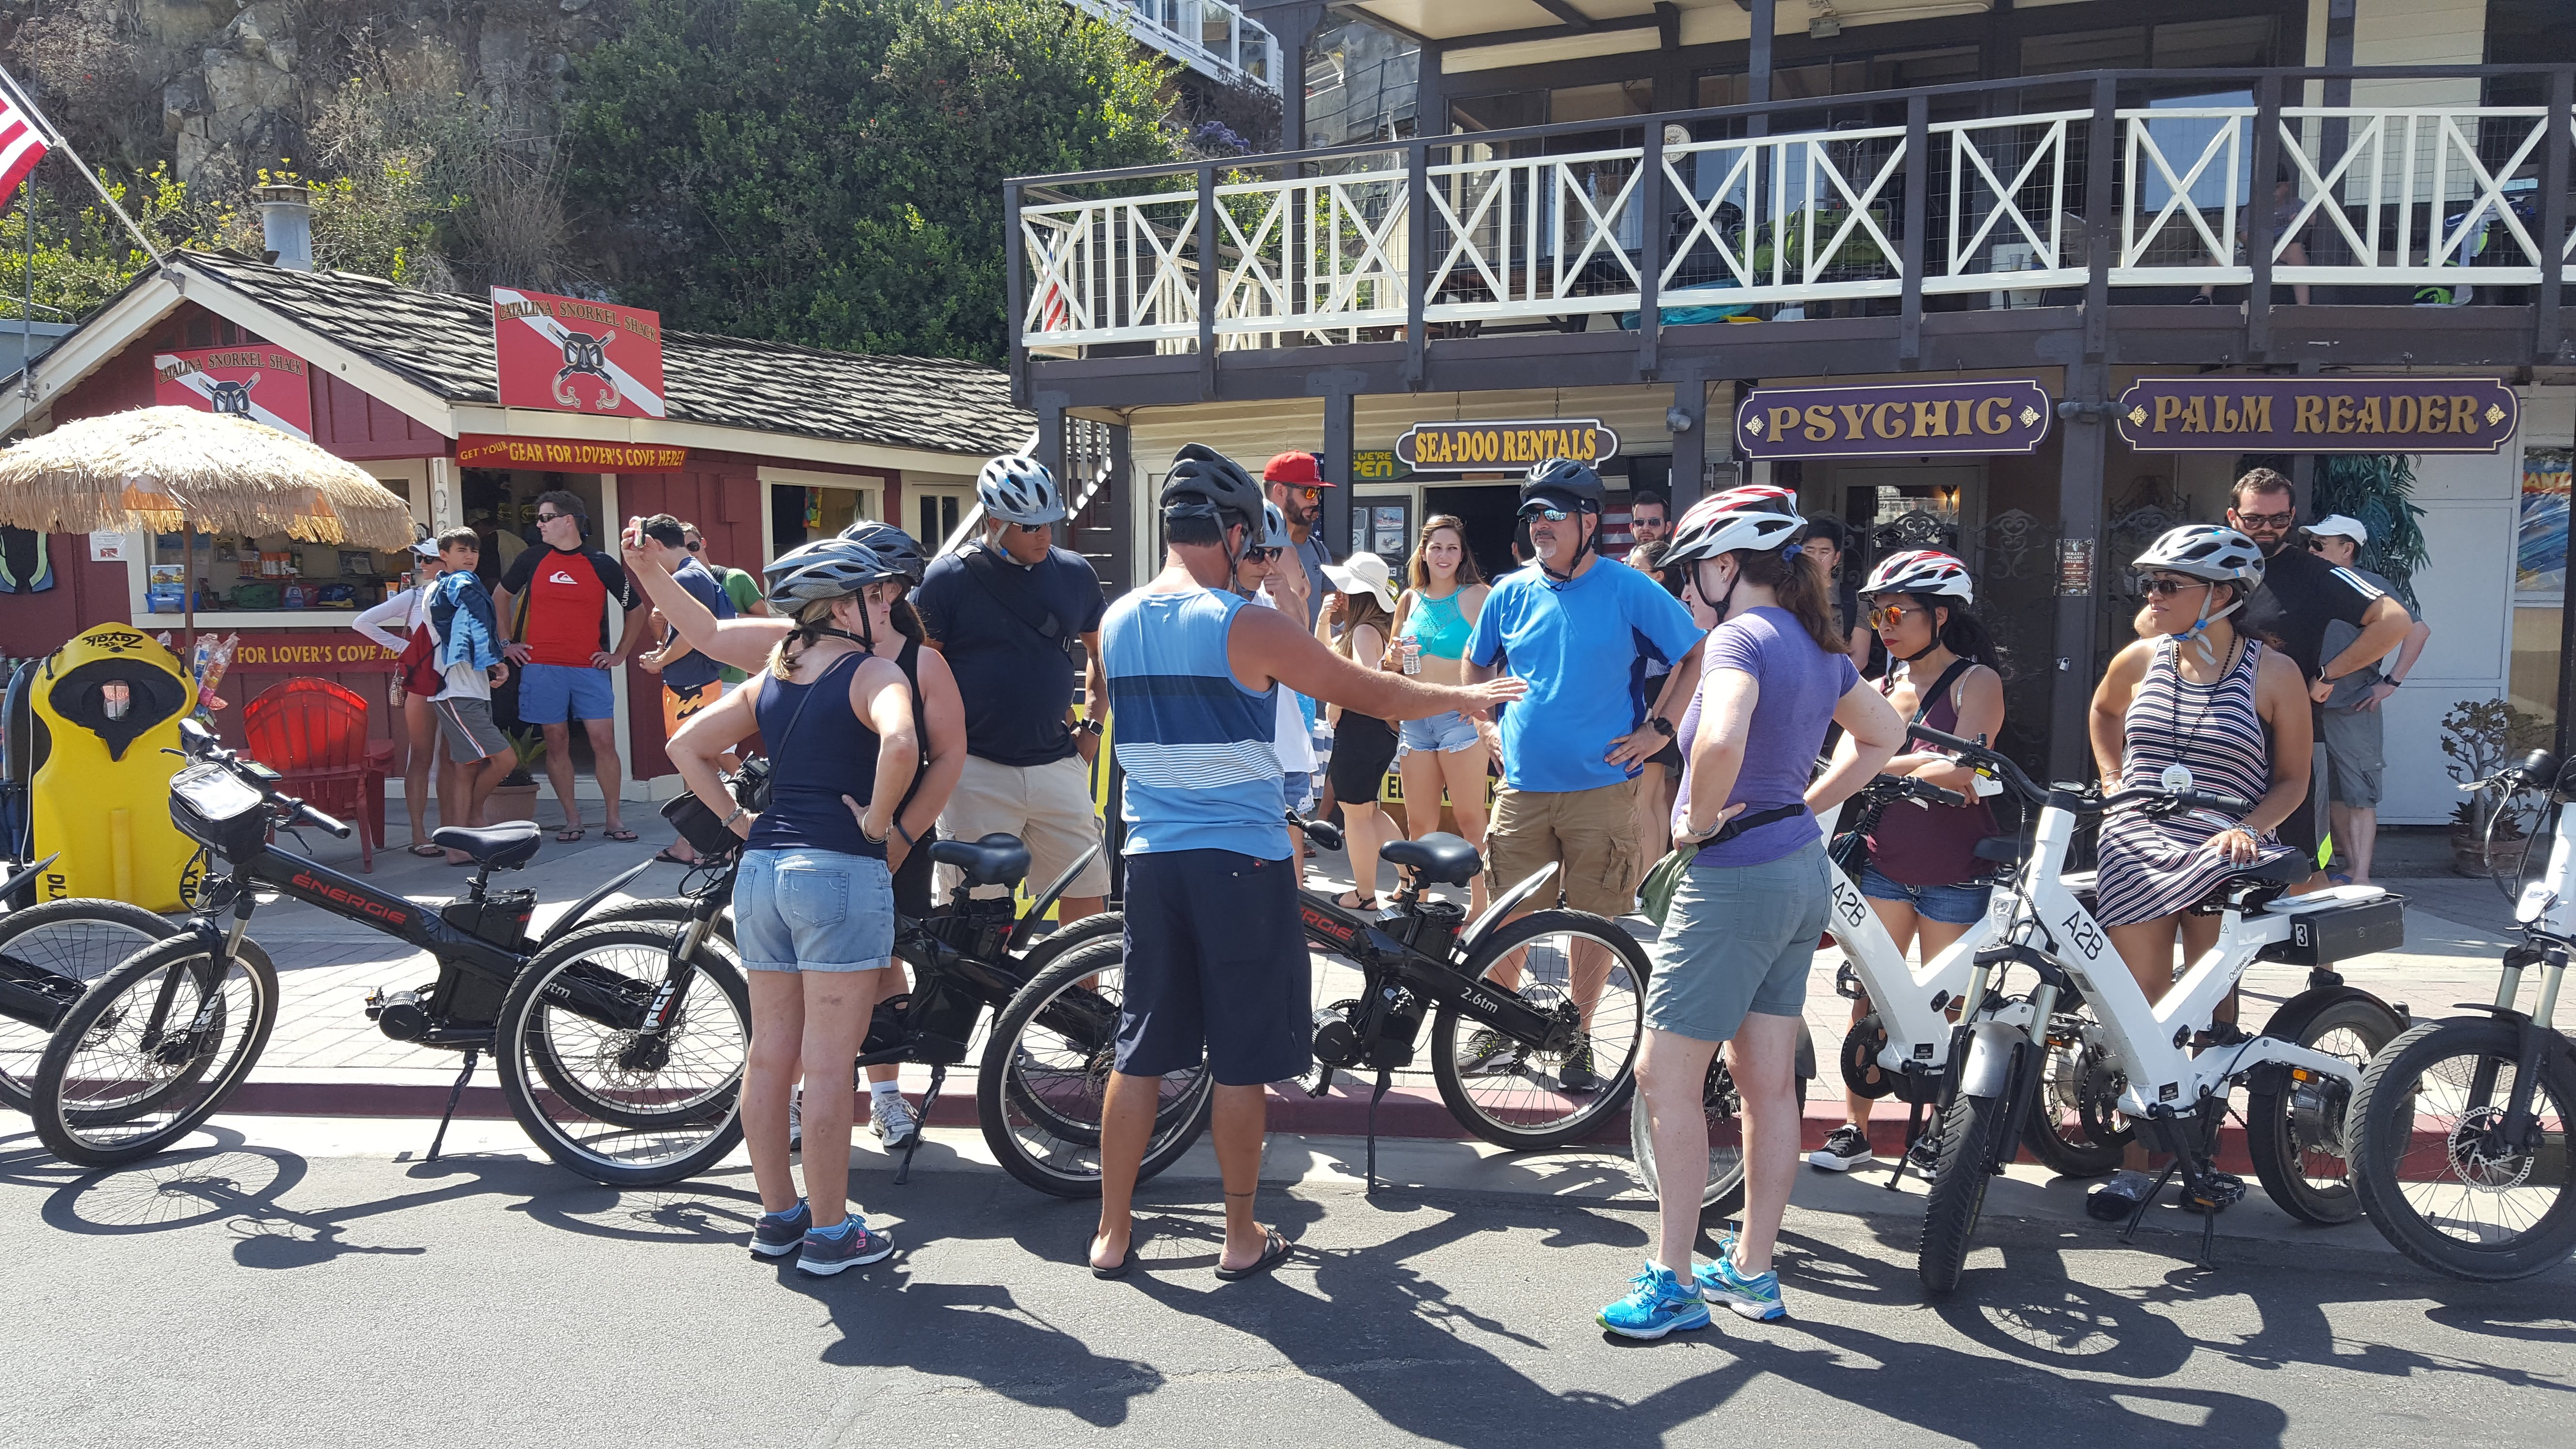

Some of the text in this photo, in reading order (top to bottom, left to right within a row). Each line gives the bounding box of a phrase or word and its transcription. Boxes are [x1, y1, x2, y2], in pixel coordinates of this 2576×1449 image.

[499, 301, 658, 343] CATALINA SNORKEL SHACK
[159, 352, 303, 384] CATALINA SNORKEL SHACK
[1766, 396, 2012, 442] PSYCHIC
[2152, 395, 2479, 434] PALM READER
[460, 441, 685, 467] GET YOUR GEAR FOR LOVER'S COVE HERE!
[1358, 451, 1392, 460] WE'RE
[1503, 429, 1596, 461] RENTALS
[1353, 461, 1393, 477] PEN
[82, 631, 144, 649] Zayak
[237, 647, 268, 663] FOR
[272, 646, 332, 663] LOVER'S
[337, 645, 377, 662] COVE
[183, 869, 199, 899] DLX
[292, 870, 407, 924] ÉNERGIE
[1833, 882, 1867, 927] A2B
[2061, 911, 2103, 960] A2B
[2298, 925, 2307, 945] 3
[2228, 956, 2249, 981] Octave
[1460, 987, 1498, 1014] 2.6tm
